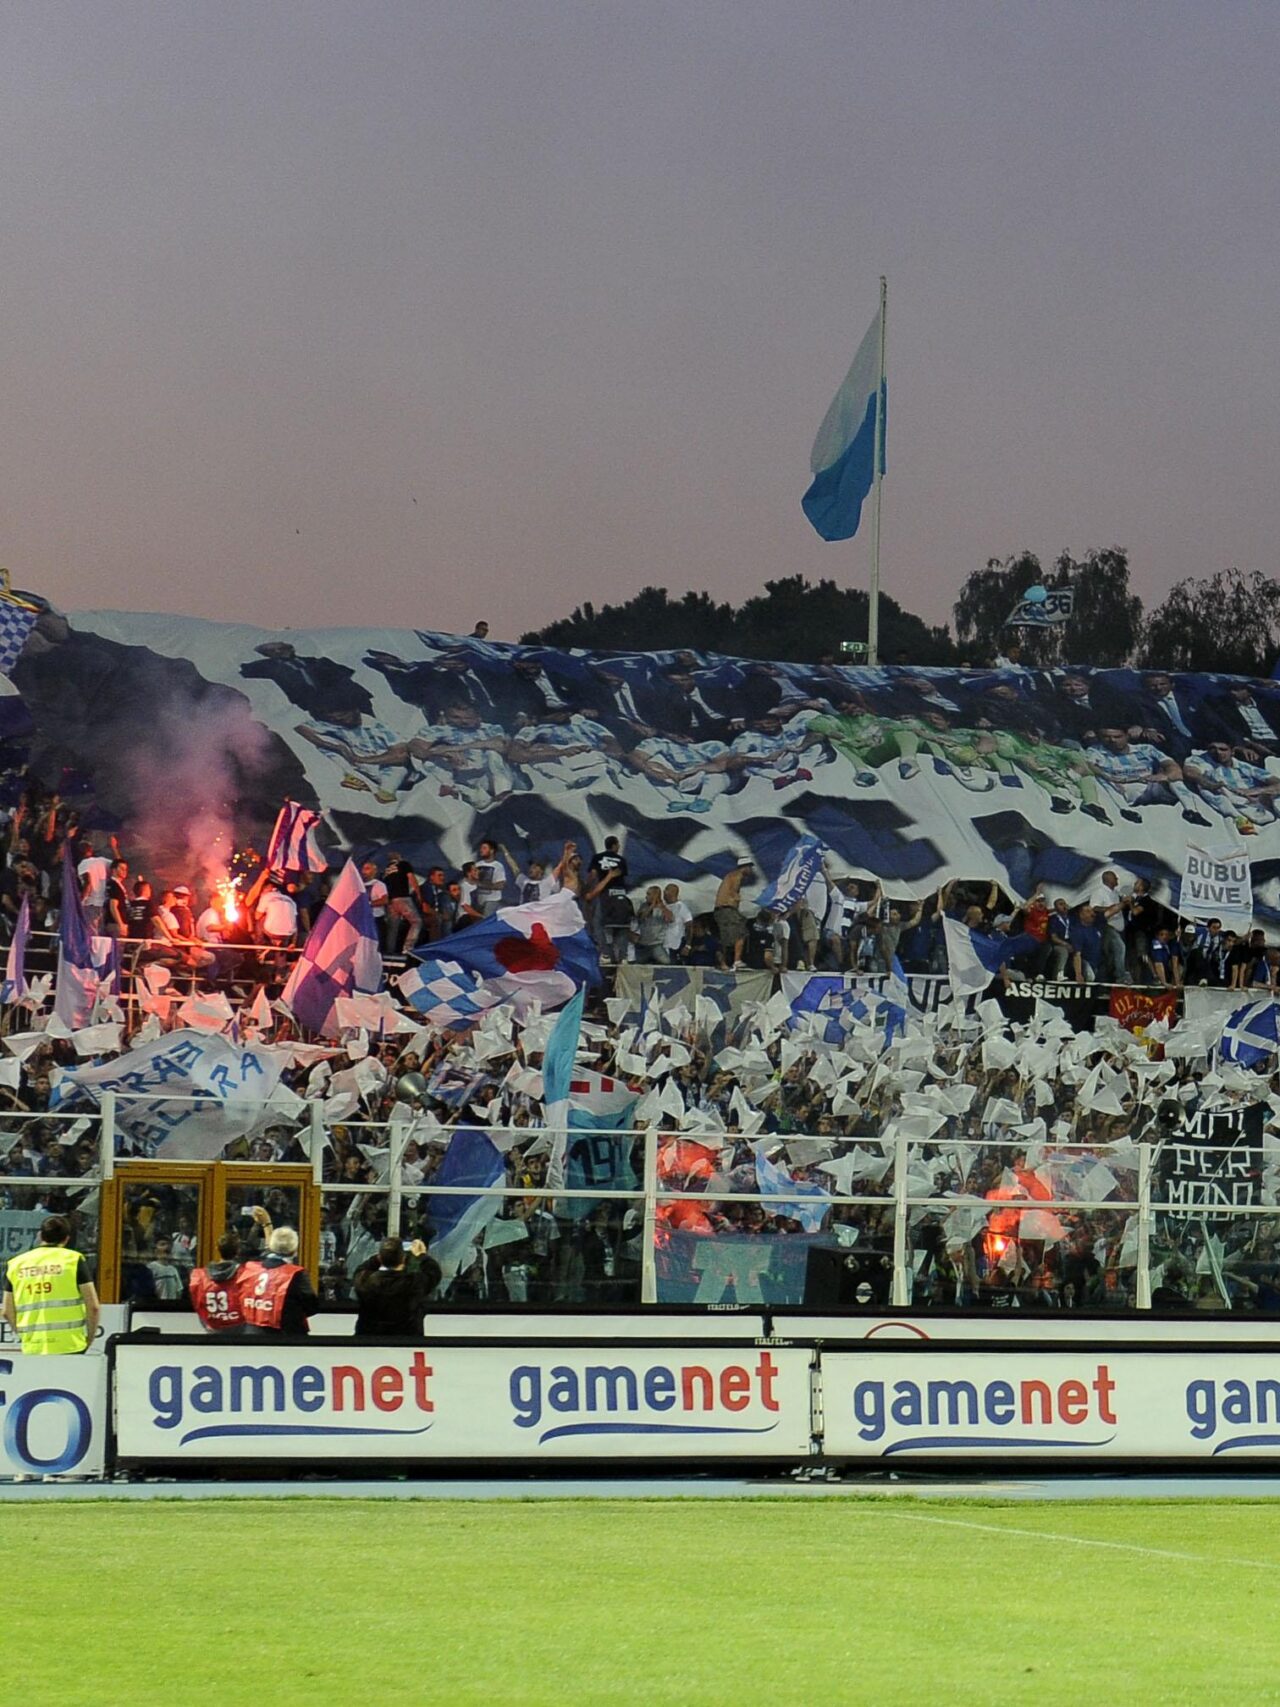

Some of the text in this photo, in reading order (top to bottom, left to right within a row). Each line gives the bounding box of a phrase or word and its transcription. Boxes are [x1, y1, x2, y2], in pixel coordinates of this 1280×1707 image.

[1190, 880, 1242, 904] VIVE
[1005, 981, 1091, 999] ASSENTI
[1172, 1143, 1252, 1178] PER
[17, 1263, 62, 1279] STEWARD
[26, 1281, 52, 1296] 139
[254, 1273, 270, 1295] 3
[206, 1291, 228, 1313] 53
[243, 1298, 273, 1312] RGC
[148, 1351, 434, 1429] gamenet
[511, 1351, 780, 1428] gamenet
[854, 1365, 1117, 1441] gamenet
